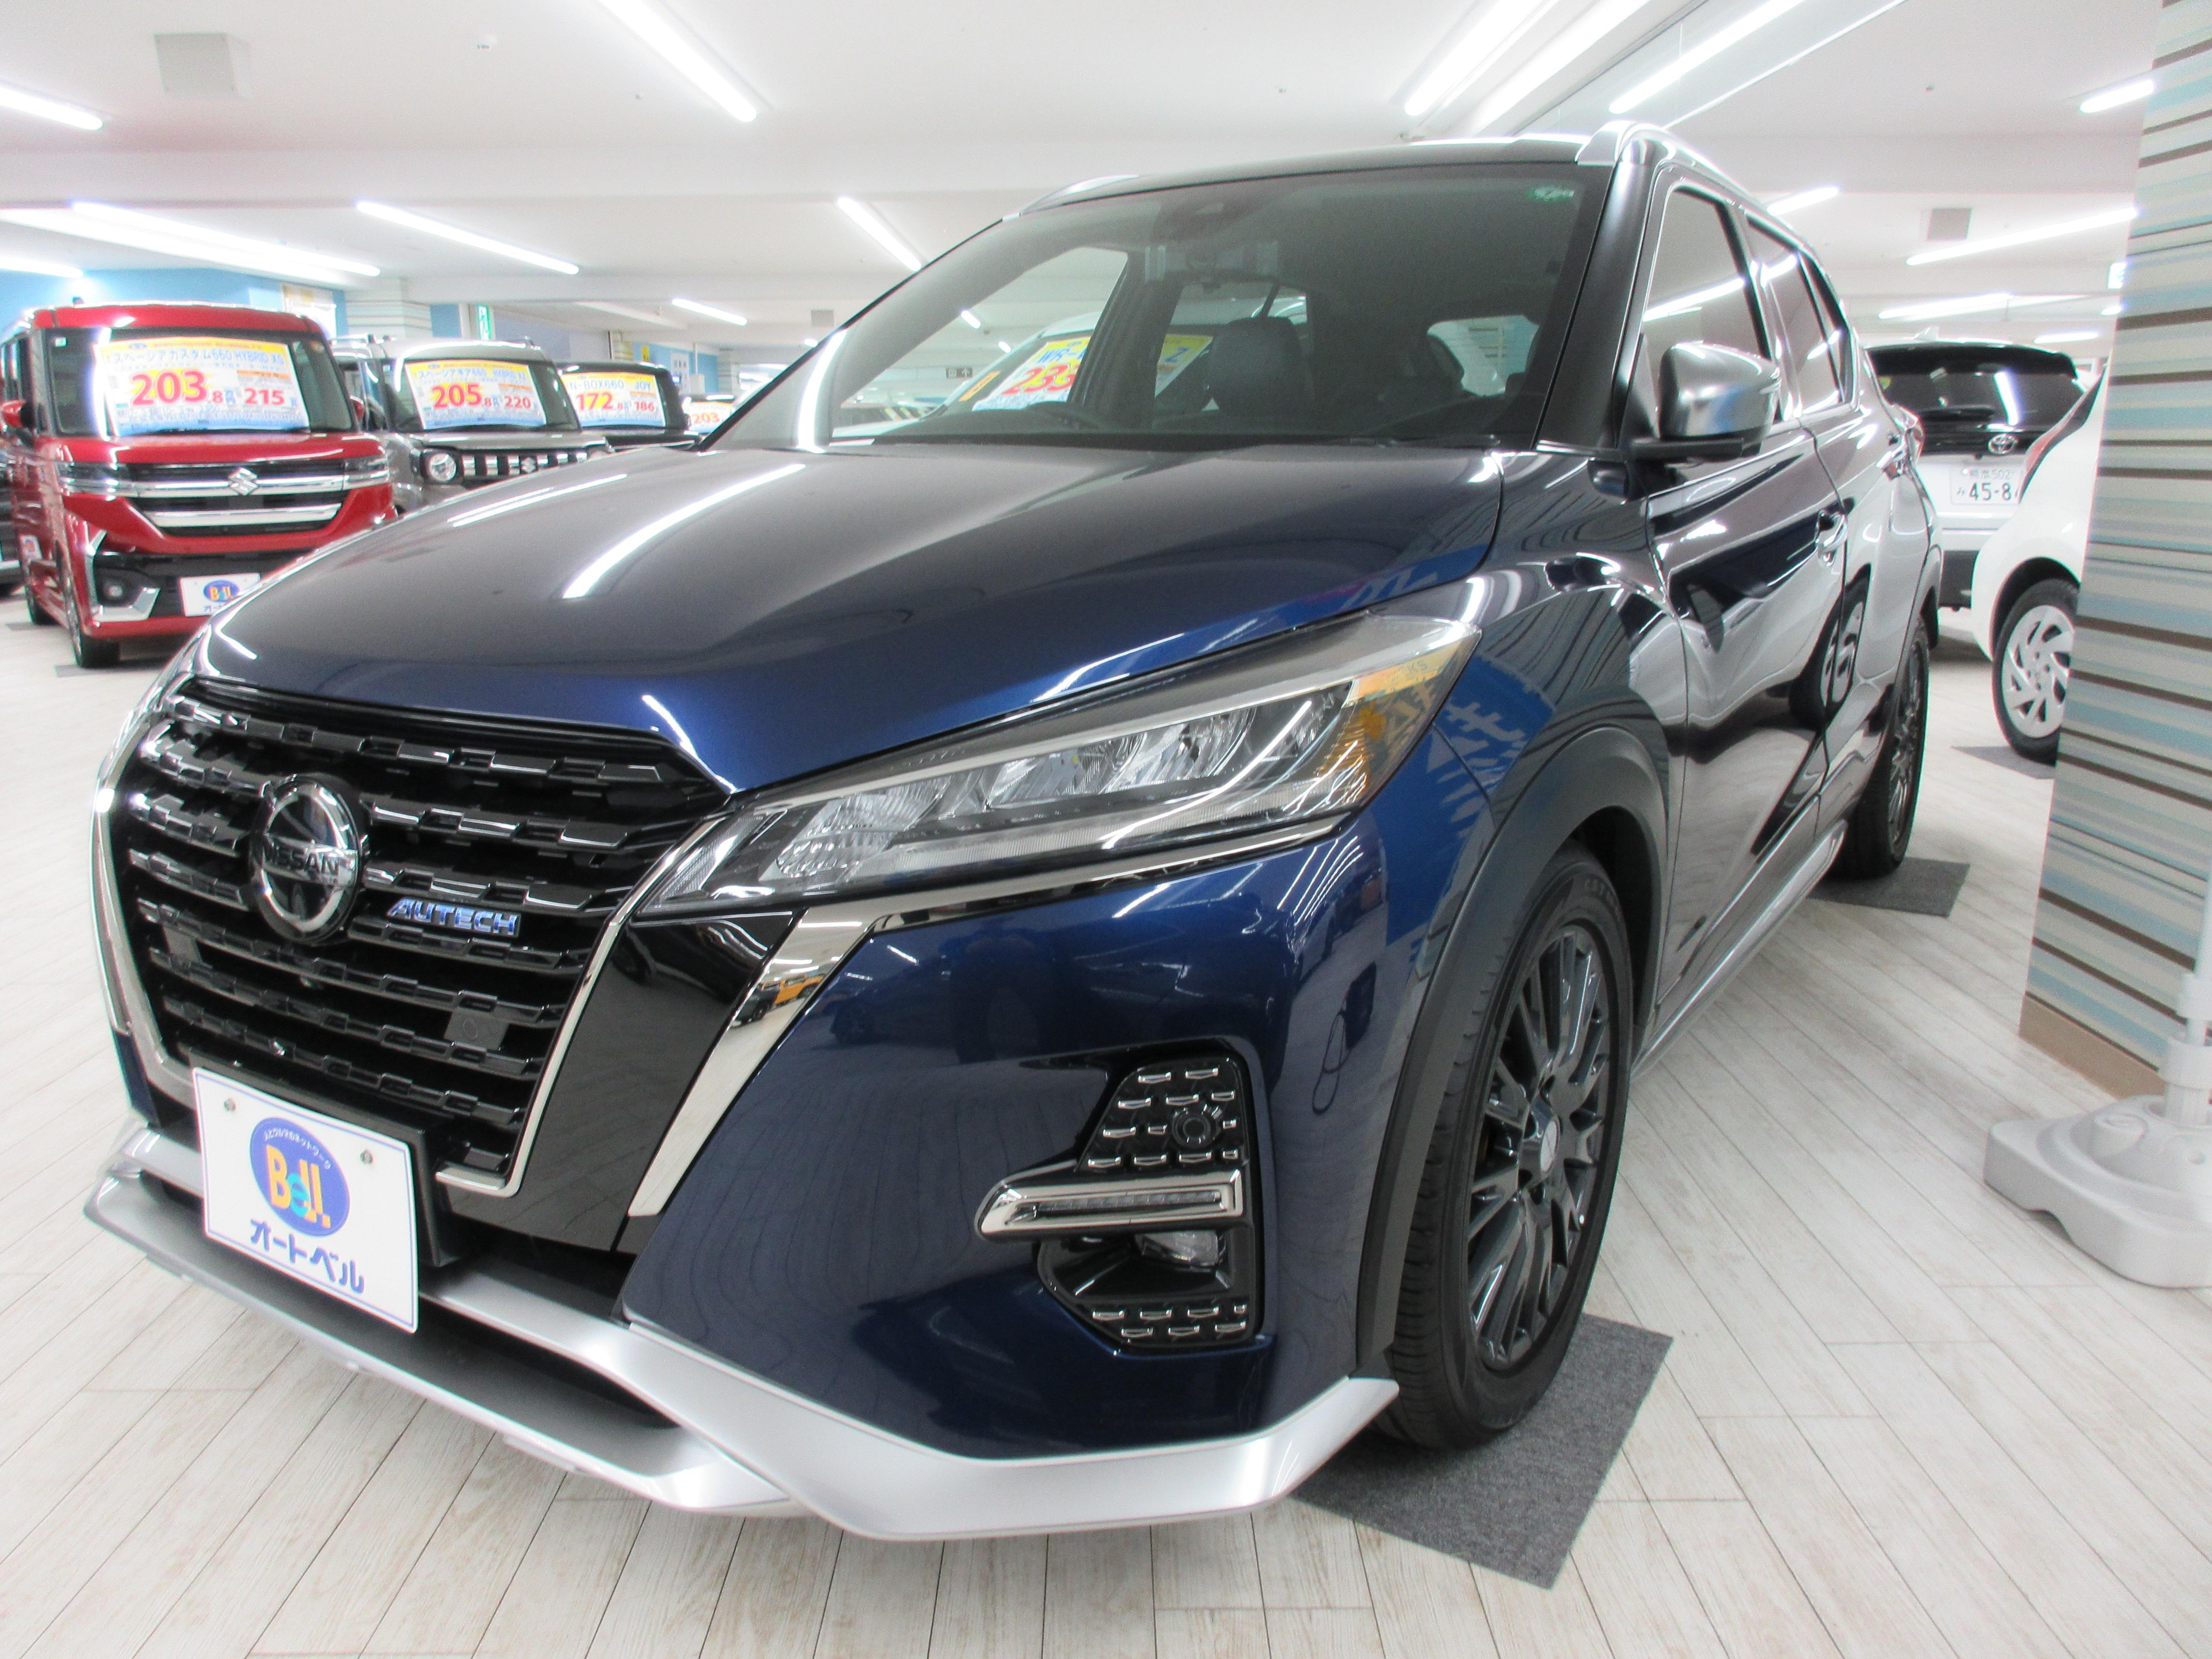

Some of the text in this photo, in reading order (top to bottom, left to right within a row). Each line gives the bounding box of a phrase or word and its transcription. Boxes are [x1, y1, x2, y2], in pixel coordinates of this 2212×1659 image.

[244, 387, 285, 406] 215
[504, 395, 531, 409] 220
[1969, 482, 2018, 501] 45-8
[264, 841, 340, 876] NISSAN
[387, 897, 518, 935] AUTECH
[250, 1218, 364, 1293] オートベル
